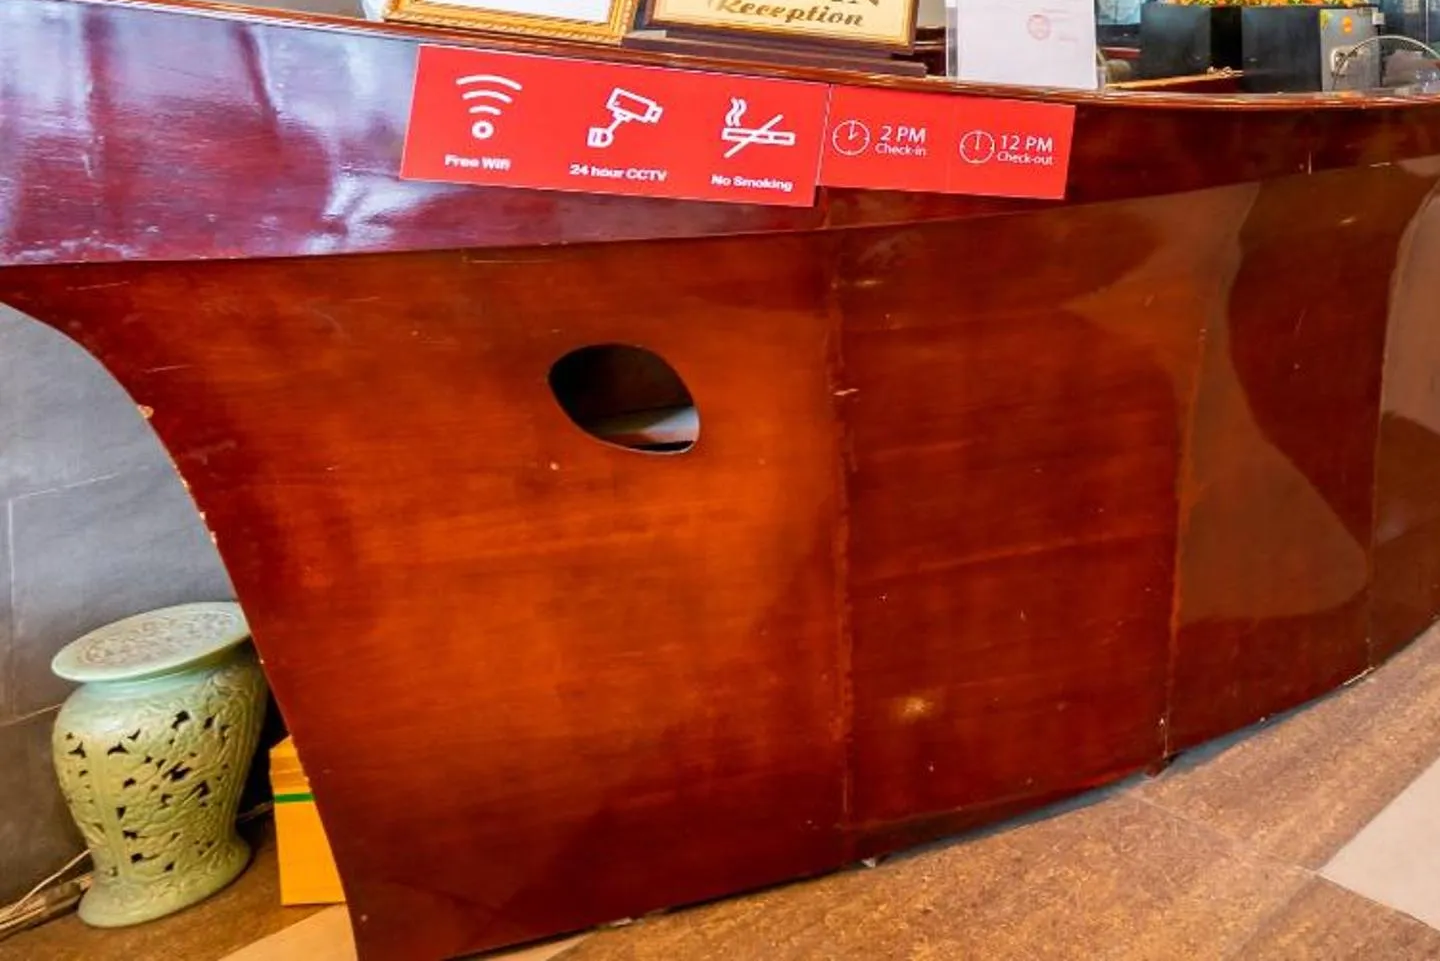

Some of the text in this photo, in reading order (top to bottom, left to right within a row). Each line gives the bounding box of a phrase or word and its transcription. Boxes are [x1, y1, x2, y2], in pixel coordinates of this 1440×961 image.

[880, 125, 927, 144] 2 PM
[875, 143, 927, 157] Check-in
[1001, 135, 1053, 153] 12 PM
[444, 153, 512, 171] Free Wifi
[997, 150, 1053, 166] Check-out
[569, 163, 668, 182] 24 hour CCTV
[711, 174, 794, 193] No Smoking
